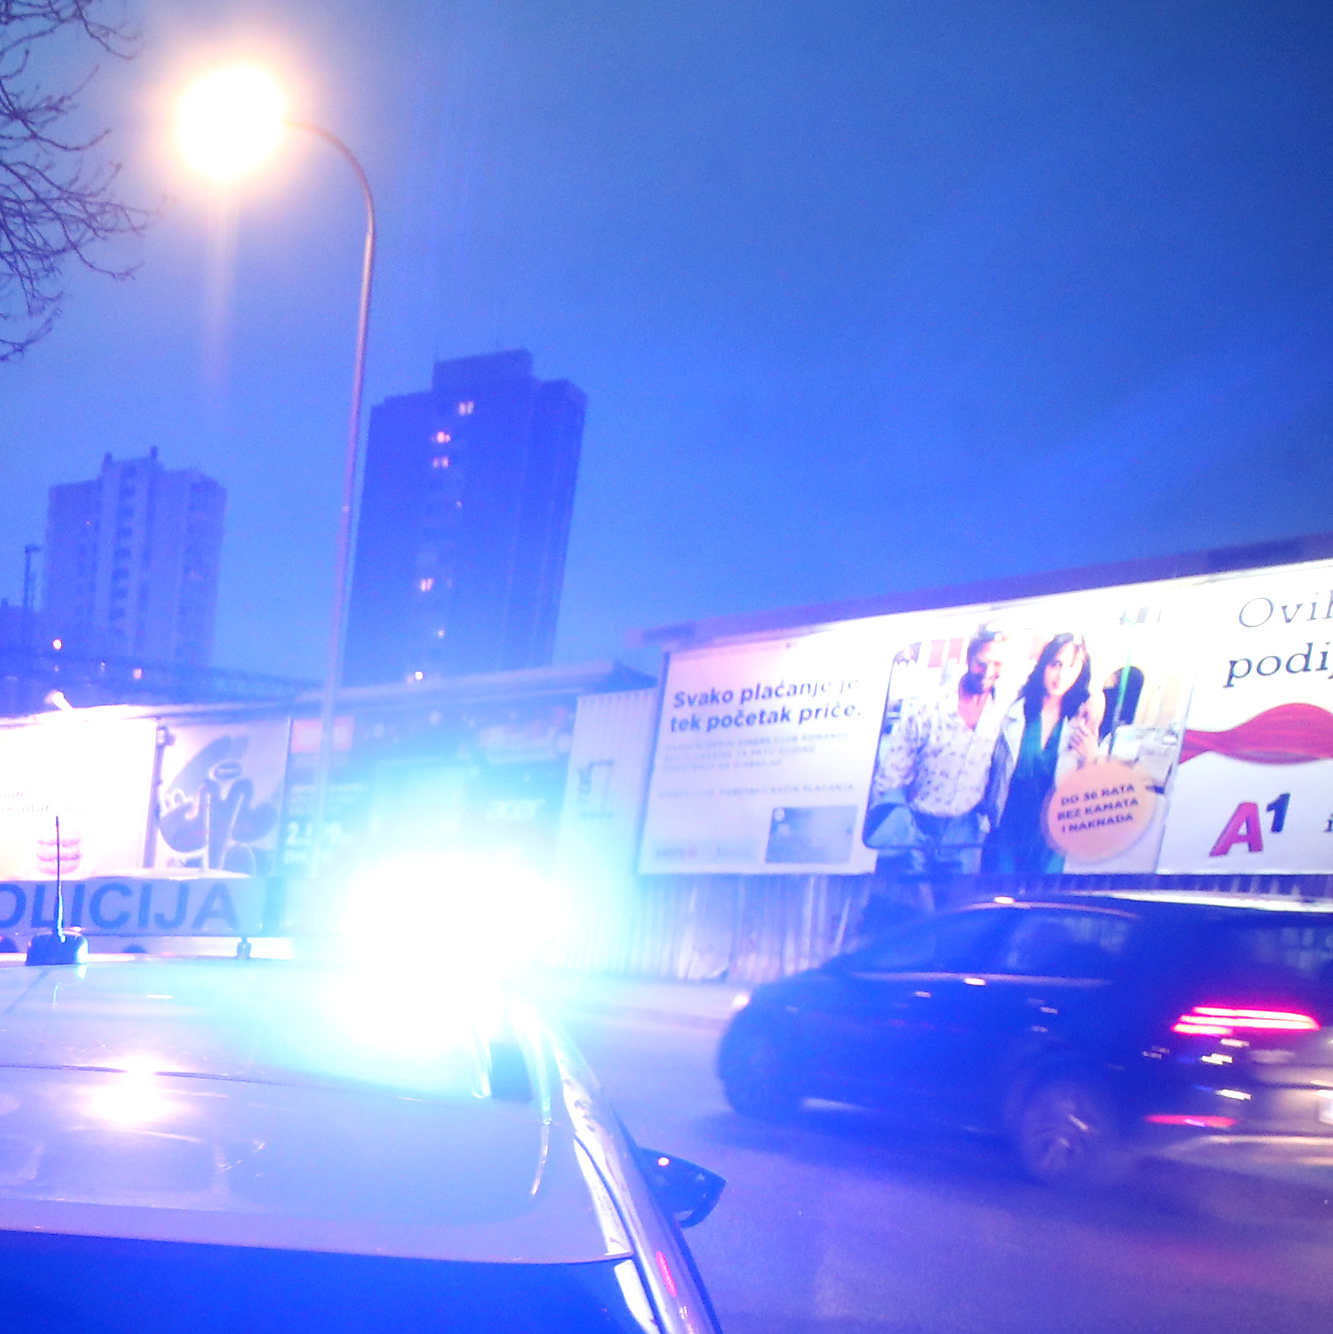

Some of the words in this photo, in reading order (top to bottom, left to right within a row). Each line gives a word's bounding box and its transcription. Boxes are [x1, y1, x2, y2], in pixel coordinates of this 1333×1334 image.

[1223, 641, 1333, 688] podi
[674, 688, 734, 708] Svako
[671, 713, 700, 732] tek
[707, 706, 792, 732] početak
[1209, 793, 1291, 857] A1
